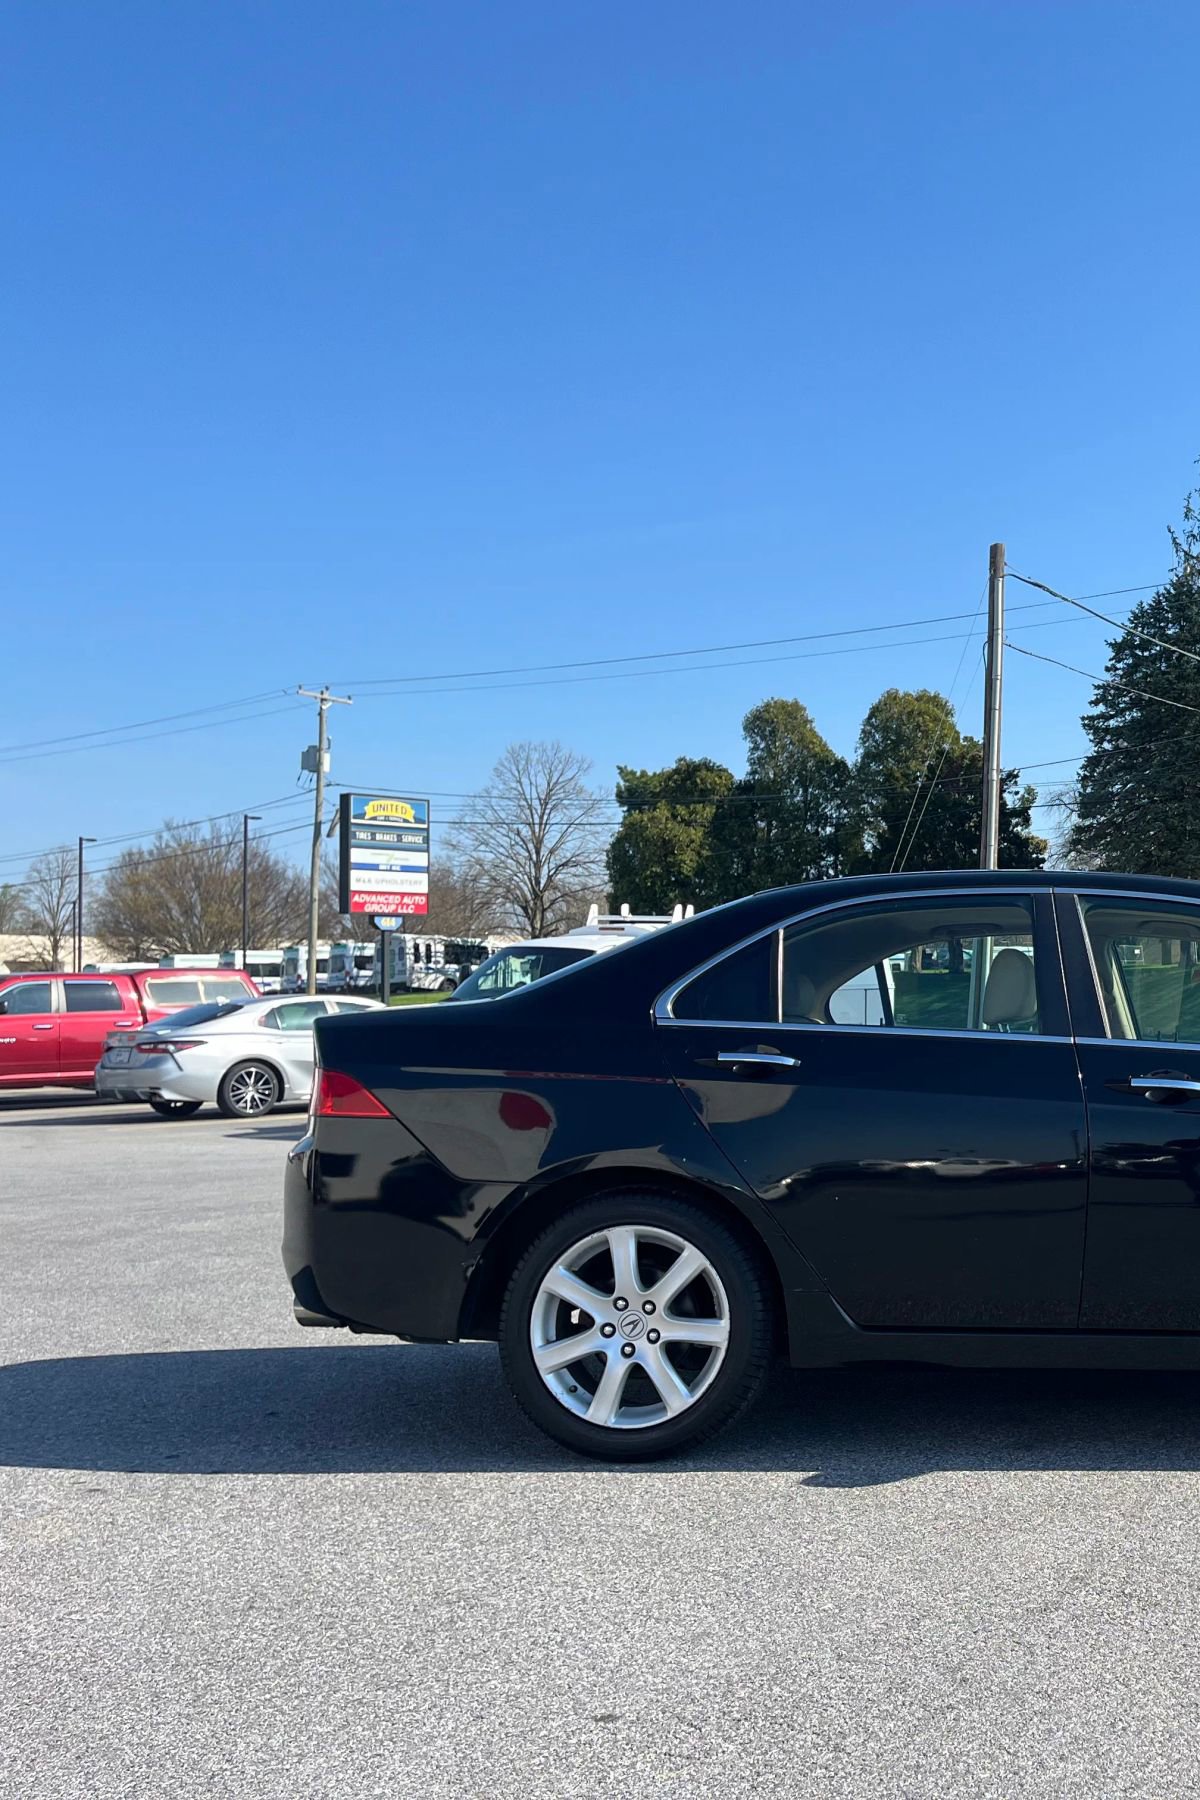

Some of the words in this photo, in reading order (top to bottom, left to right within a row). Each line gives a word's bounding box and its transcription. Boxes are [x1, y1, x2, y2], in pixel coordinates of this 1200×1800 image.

[372, 803, 407, 815] UNITED
[356, 831, 371, 841] TIRES
[375, 833, 397, 842] BRAKES
[401, 834, 423, 844] SERVICE
[375, 877, 423, 885] UPHOLSTERY
[352, 893, 401, 904] ADVANCED
[402, 896, 425, 905] AUTO
[364, 903, 397, 913] GROUP
[397, 904, 415, 914] LLC
